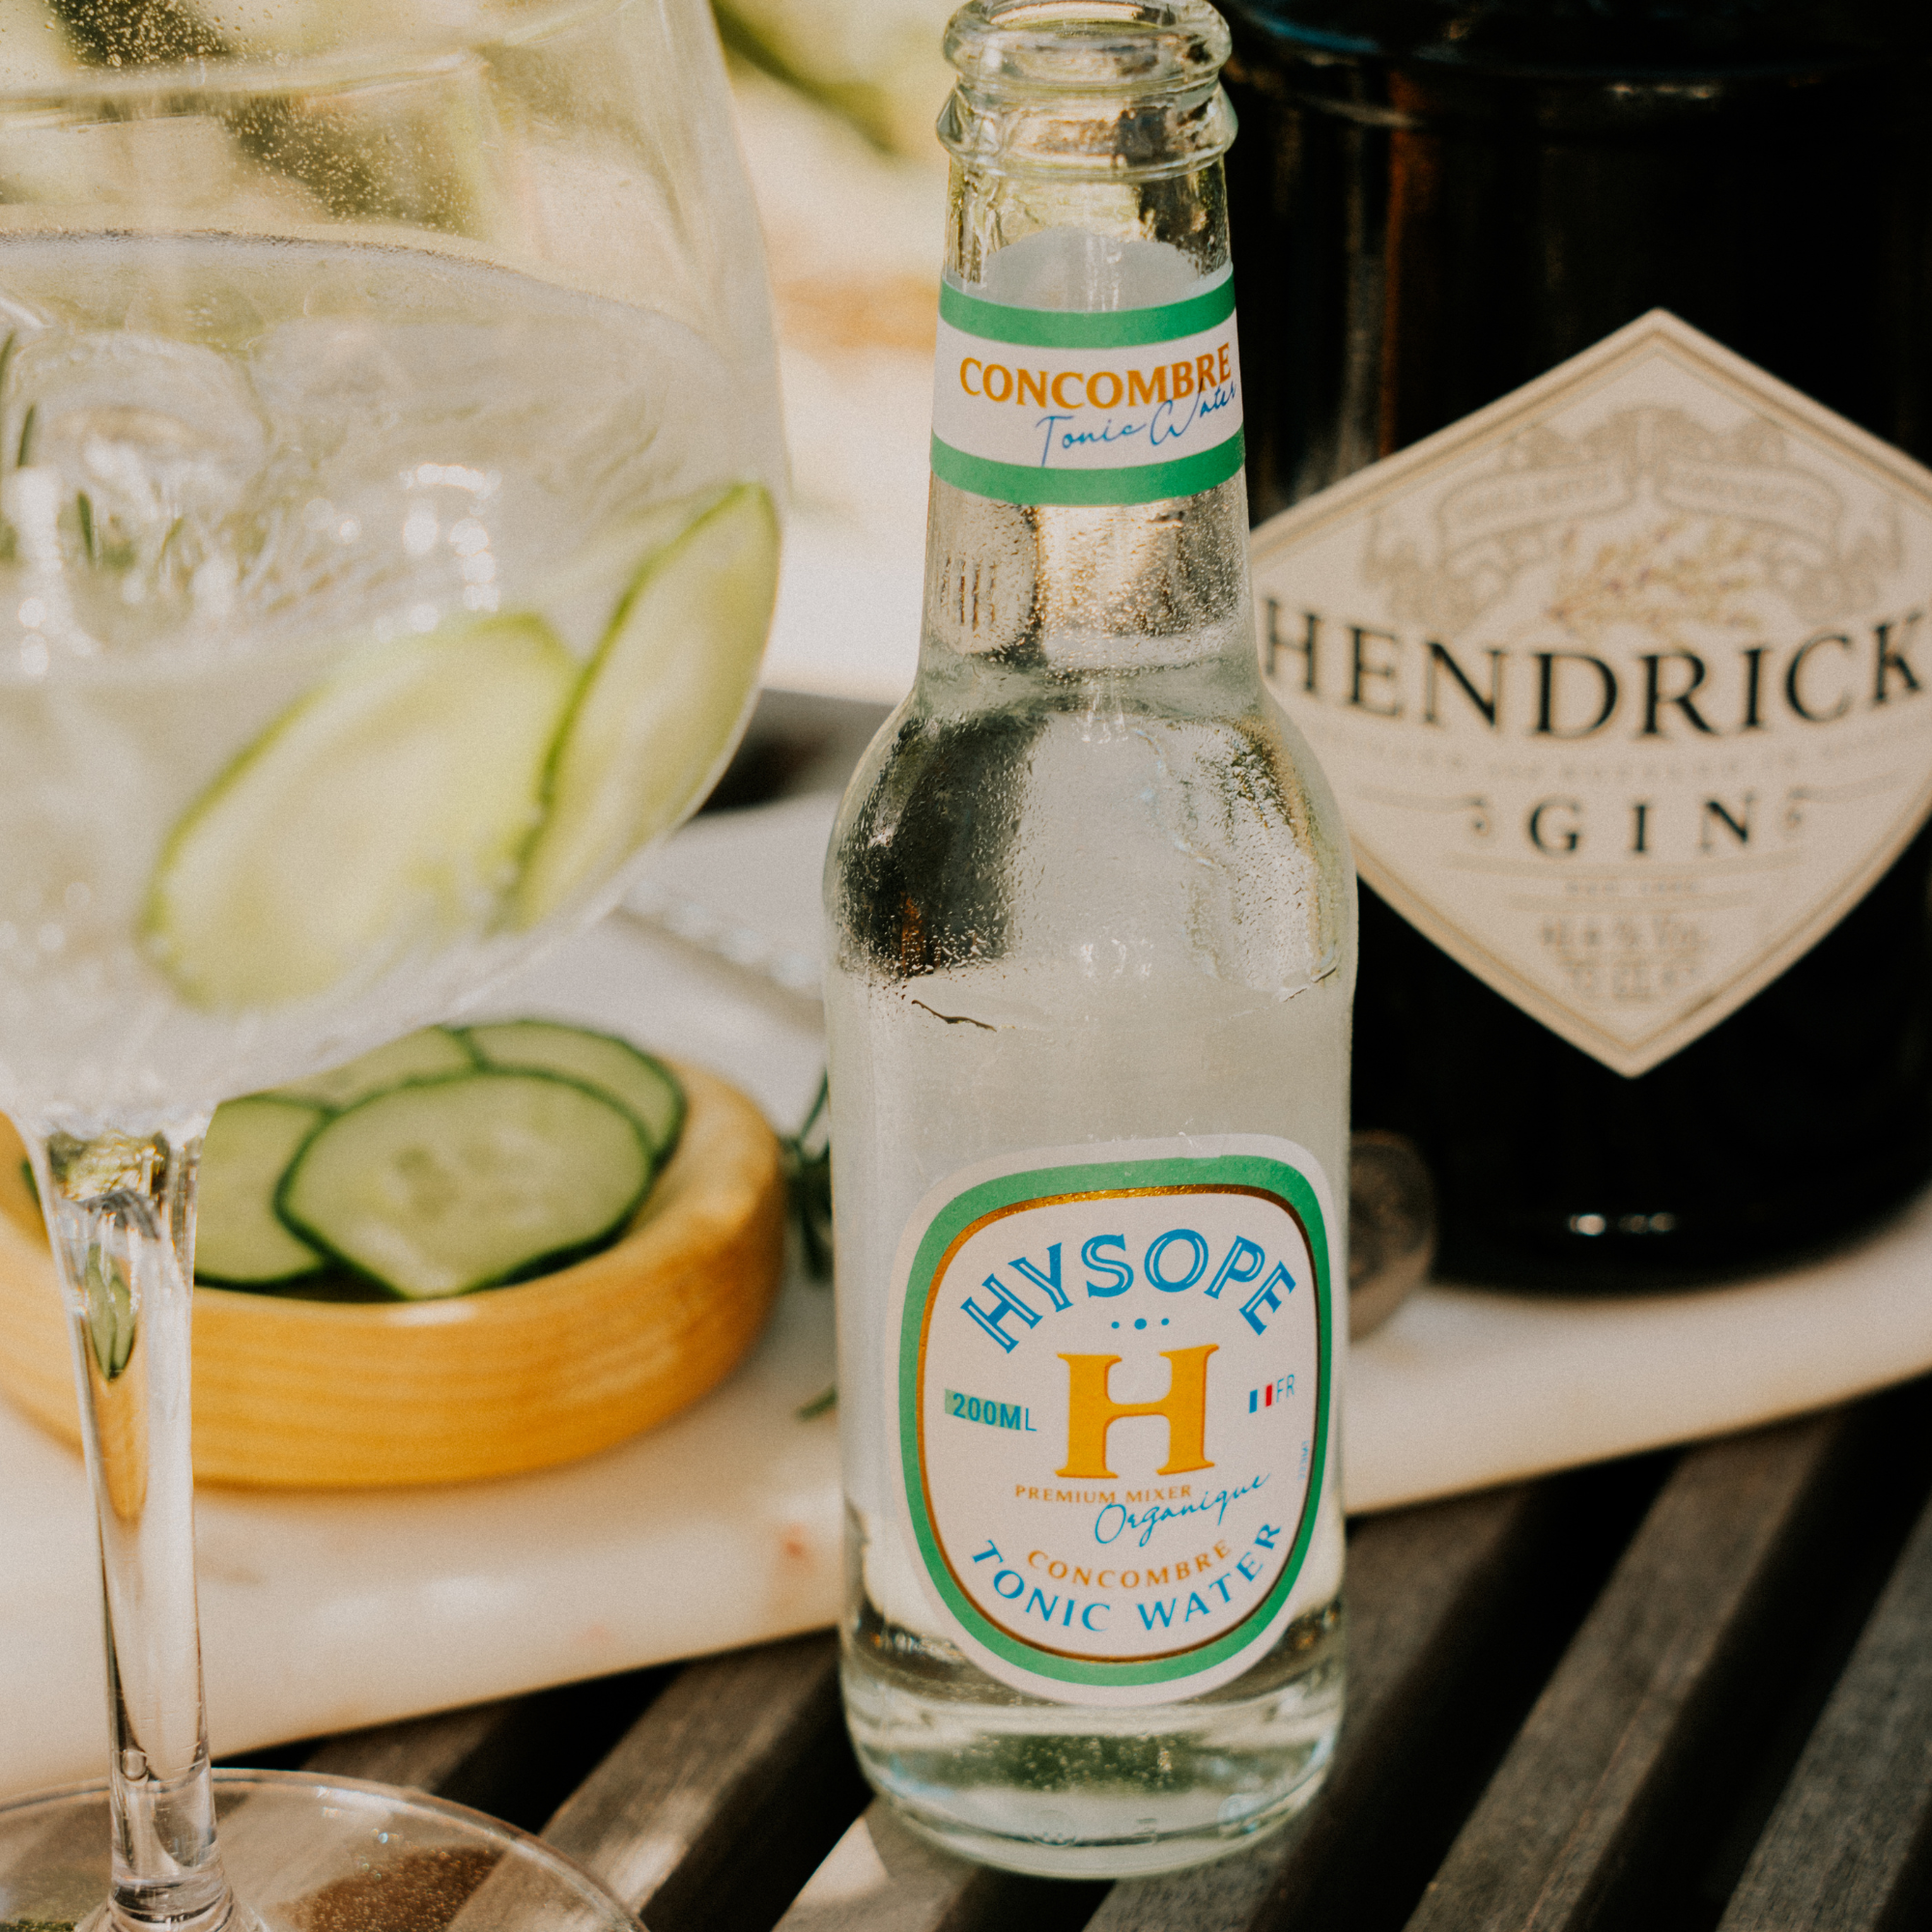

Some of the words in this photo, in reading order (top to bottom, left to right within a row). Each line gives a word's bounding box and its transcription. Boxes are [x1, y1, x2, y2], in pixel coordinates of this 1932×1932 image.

[960, 342, 1232, 410] CONCOMBRE
[1036, 415, 1147, 468] Tonic
[1527, 788, 1760, 860] GIN
[960, 1228, 1296, 1354] HYSOPE
[952, 1392, 1037, 1432] 200ML
[1055, 1344, 1219, 1479] H
[1276, 1374, 1295, 1403] FR
[1015, 1484, 1117, 1504] PREMIUM
[1125, 1484, 1192, 1504] MIXER
[1094, 1473, 1270, 1548] Organique
[972, 1539, 1111, 1632] TONIC
[1136, 1523, 1281, 1632] WATER
[1027, 1539, 1232, 1589] CONCOMBRE
